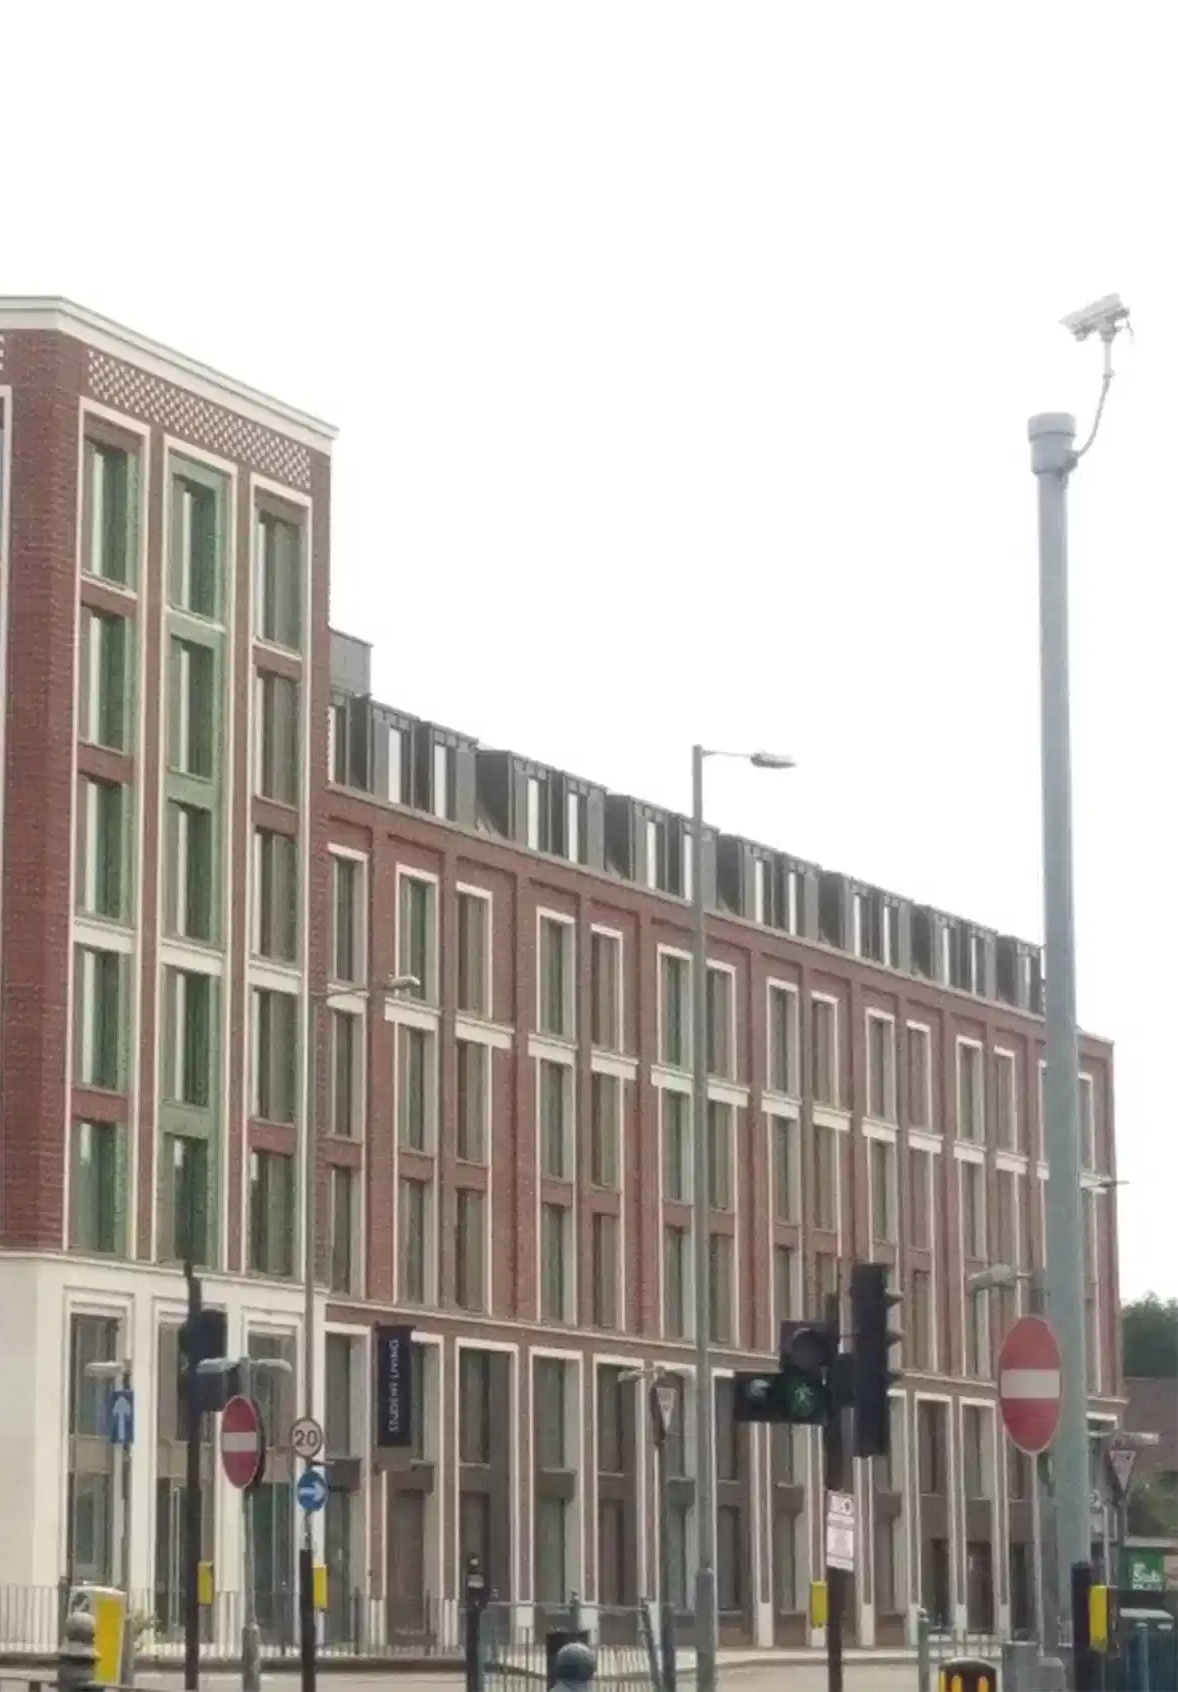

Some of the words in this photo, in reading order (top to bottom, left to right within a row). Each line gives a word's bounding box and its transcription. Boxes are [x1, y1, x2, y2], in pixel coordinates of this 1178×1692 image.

[389, 1338, 399, 1378] LIVING
[389, 1383, 399, 1433] STUDENT
[295, 1430, 318, 1447] 20
